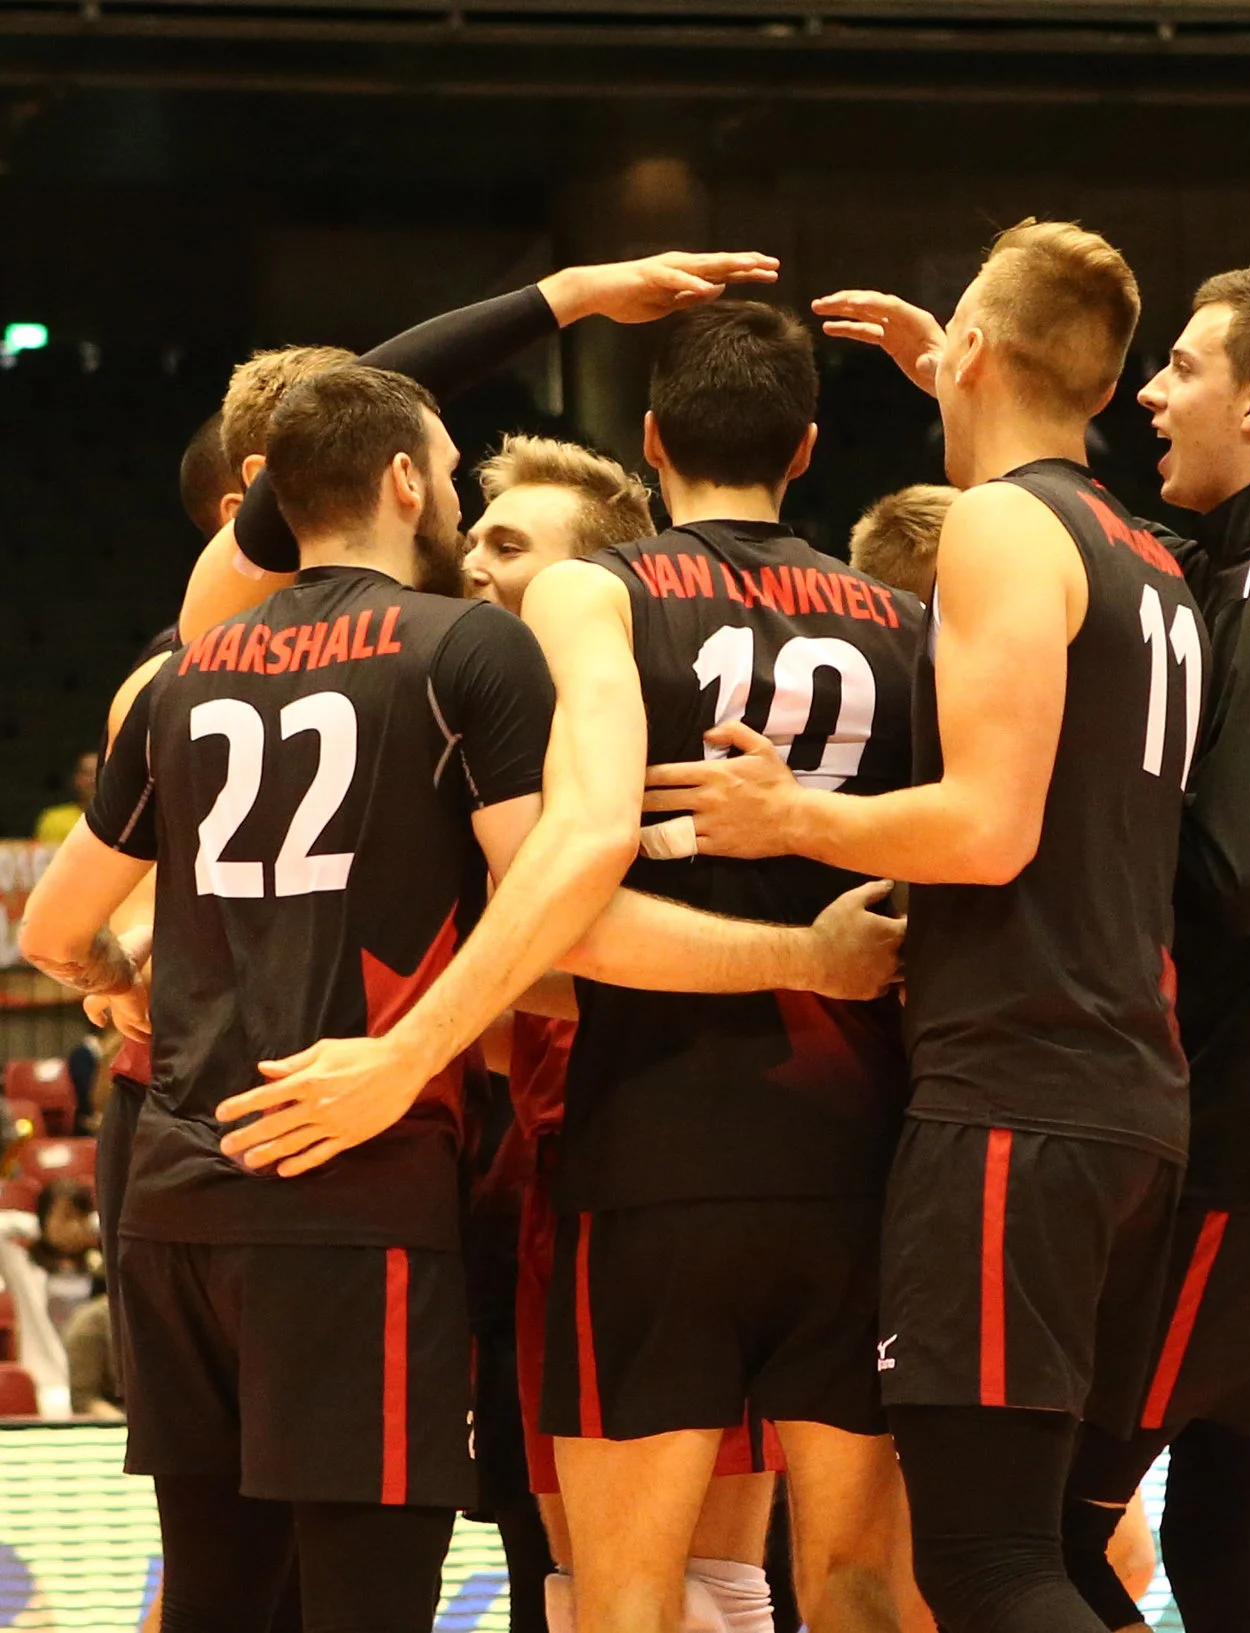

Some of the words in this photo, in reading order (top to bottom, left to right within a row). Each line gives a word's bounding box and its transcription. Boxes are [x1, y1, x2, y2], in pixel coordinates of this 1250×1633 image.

[178, 606, 402, 676] MARSHALL
[631, 553, 714, 599] VAN
[720, 562, 900, 629] LANKVELT
[692, 625, 876, 793] 10
[1139, 583, 1202, 792] 11
[190, 692, 358, 898] 22
